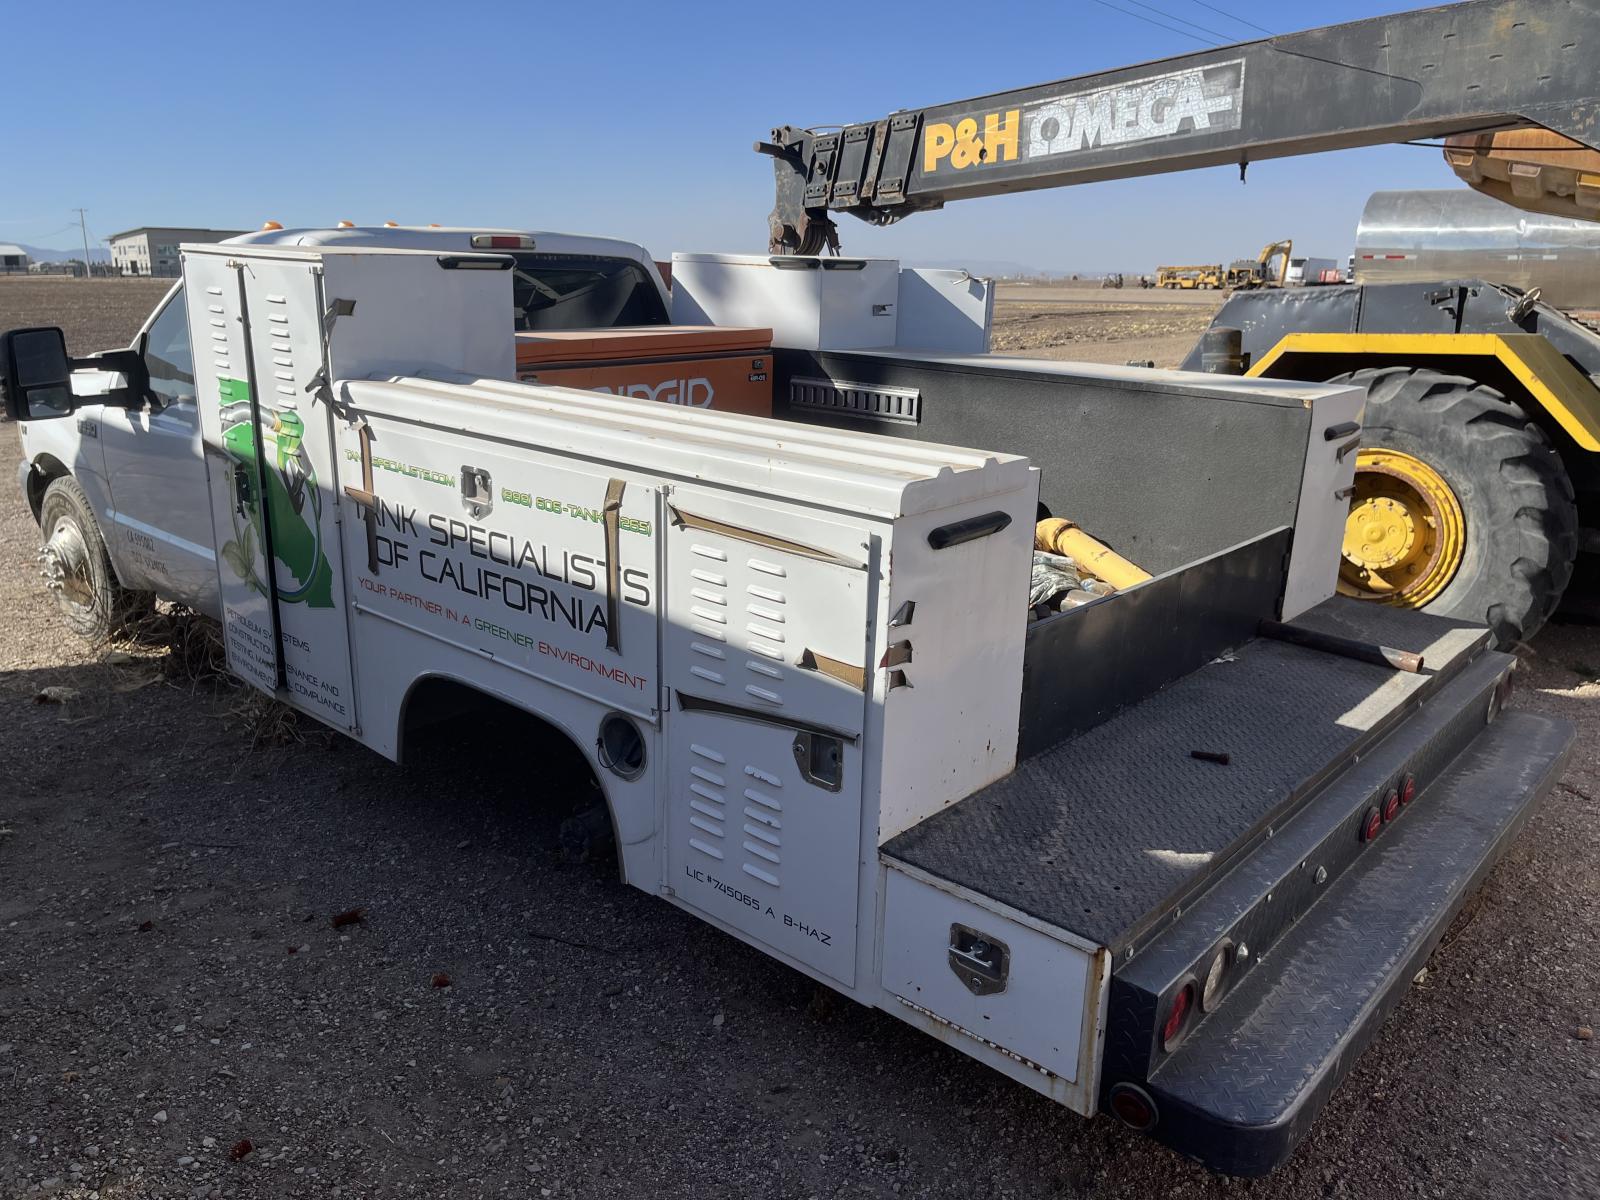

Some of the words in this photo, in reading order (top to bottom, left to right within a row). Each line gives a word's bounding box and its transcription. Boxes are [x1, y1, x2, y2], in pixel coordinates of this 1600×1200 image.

[924, 109, 1020, 172] P&H
[1028, 71, 1233, 158] OMEGA
[344, 449, 456, 488] TASPECIALISTS.COM
[501, 488, 532, 508] (888)
[356, 498, 418, 538] NK
[376, 535, 409, 569] OF
[419, 549, 609, 635] CALIFORNIA
[358, 576, 387, 598] YOUR
[390, 589, 443, 616] PARTNER
[446, 607, 458, 621] IN
[462, 615, 471, 625] A
[474, 618, 534, 649] GREENER
[538, 641, 647, 691] ENVIRONMENT
[295, 682, 346, 716] COMPLIANCE
[321, 680, 339, 697] AND
[686, 865, 704, 883] LIC
[765, 907, 776, 919] A
[783, 914, 832, 946] B-HAZ
